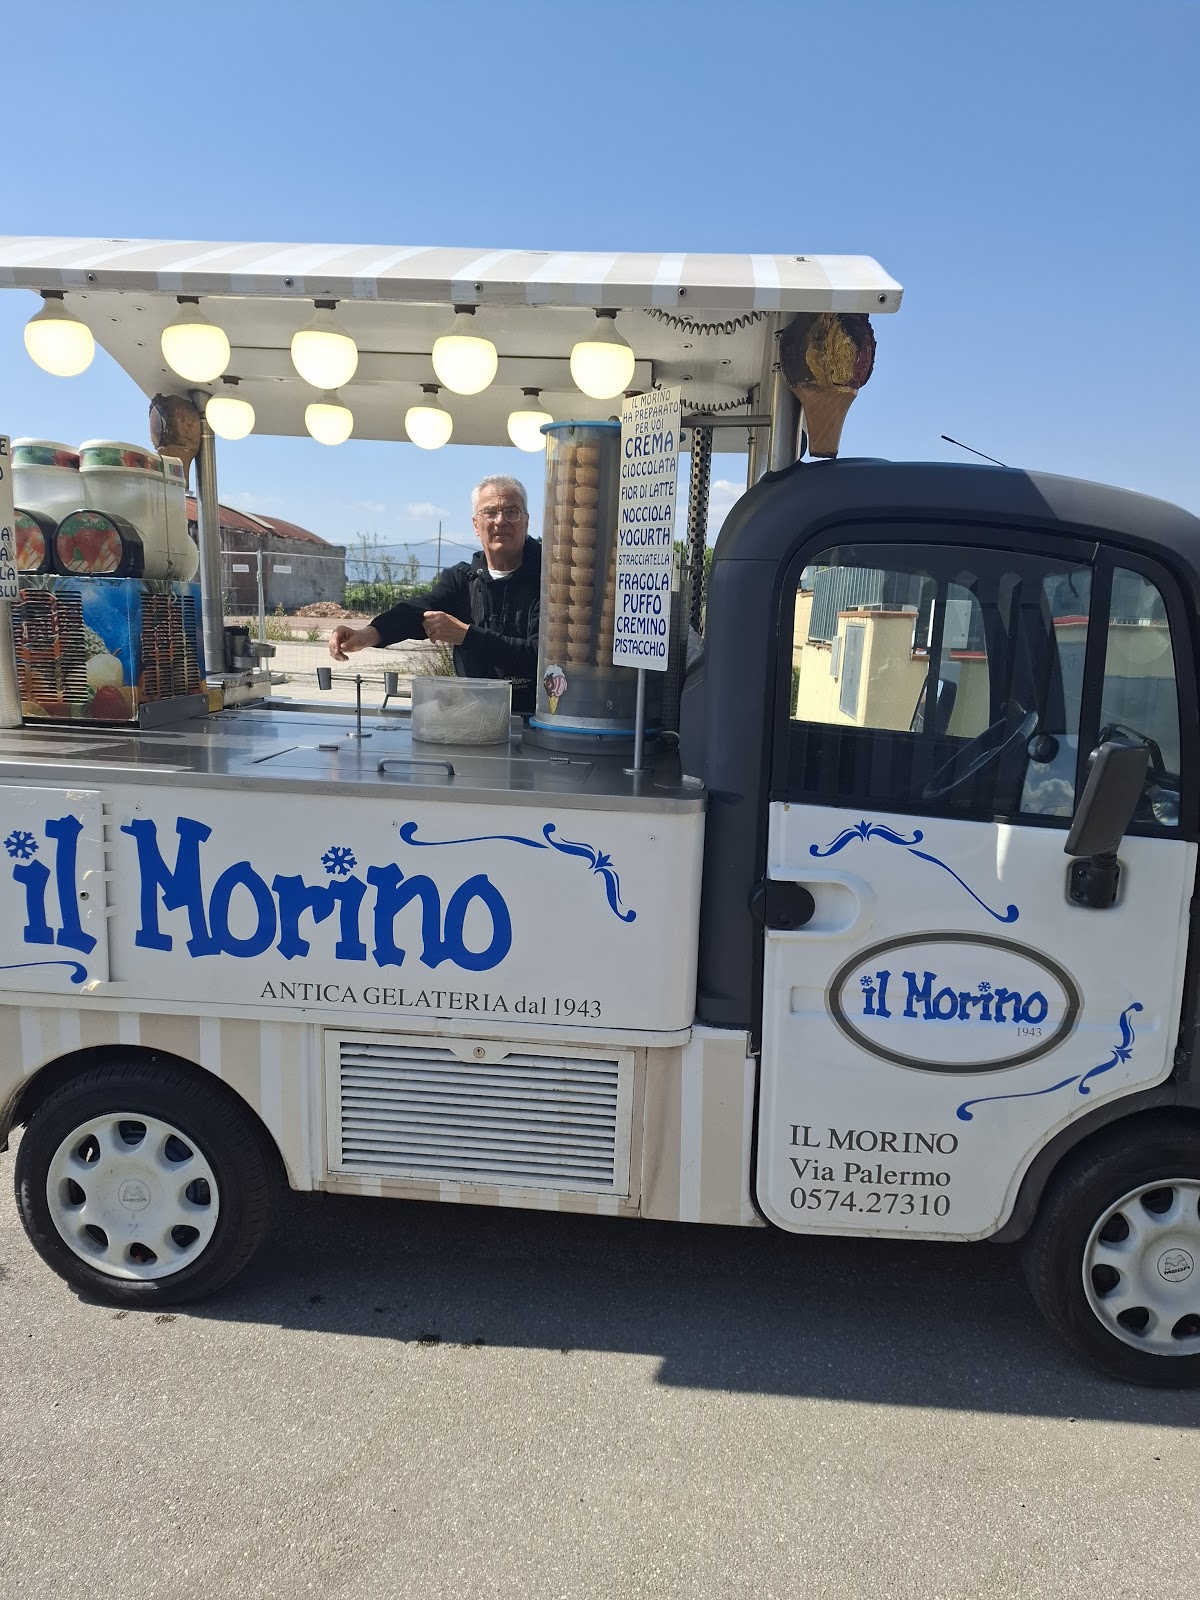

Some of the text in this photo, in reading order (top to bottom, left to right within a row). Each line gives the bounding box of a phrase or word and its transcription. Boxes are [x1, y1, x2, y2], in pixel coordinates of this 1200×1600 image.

[632, 390, 671, 408] IL MORINO
[623, 401, 679, 423] HA PREPARATO
[636, 418, 664, 434] PER VOI
[625, 430, 674, 459] CREMA
[622, 457, 676, 479] CIOCCOLATA
[621, 480, 674, 500] FIOR DI LATTE
[622, 504, 671, 524] NOCCIOLA
[619, 527, 670, 546] YOGURTH
[618, 553, 670, 566] STRACCIATELLA
[618, 572, 669, 591] FRAGOLA
[623, 593, 662, 615] PUFFO
[616, 616, 667, 636] CREMINO
[614, 637, 666, 657] PISTACCHIO
[4, 815, 513, 973] il Morino
[260, 980, 602, 1019] ANTICA GELATERIA dal 1943
[860, 970, 1049, 1025] il Morino
[1016, 1027, 1042, 1038] 1943
[789, 1124, 959, 1154] IL MORINO
[789, 1157, 951, 1186] Via Palermo
[790, 1187, 951, 1217] 0574.27310
